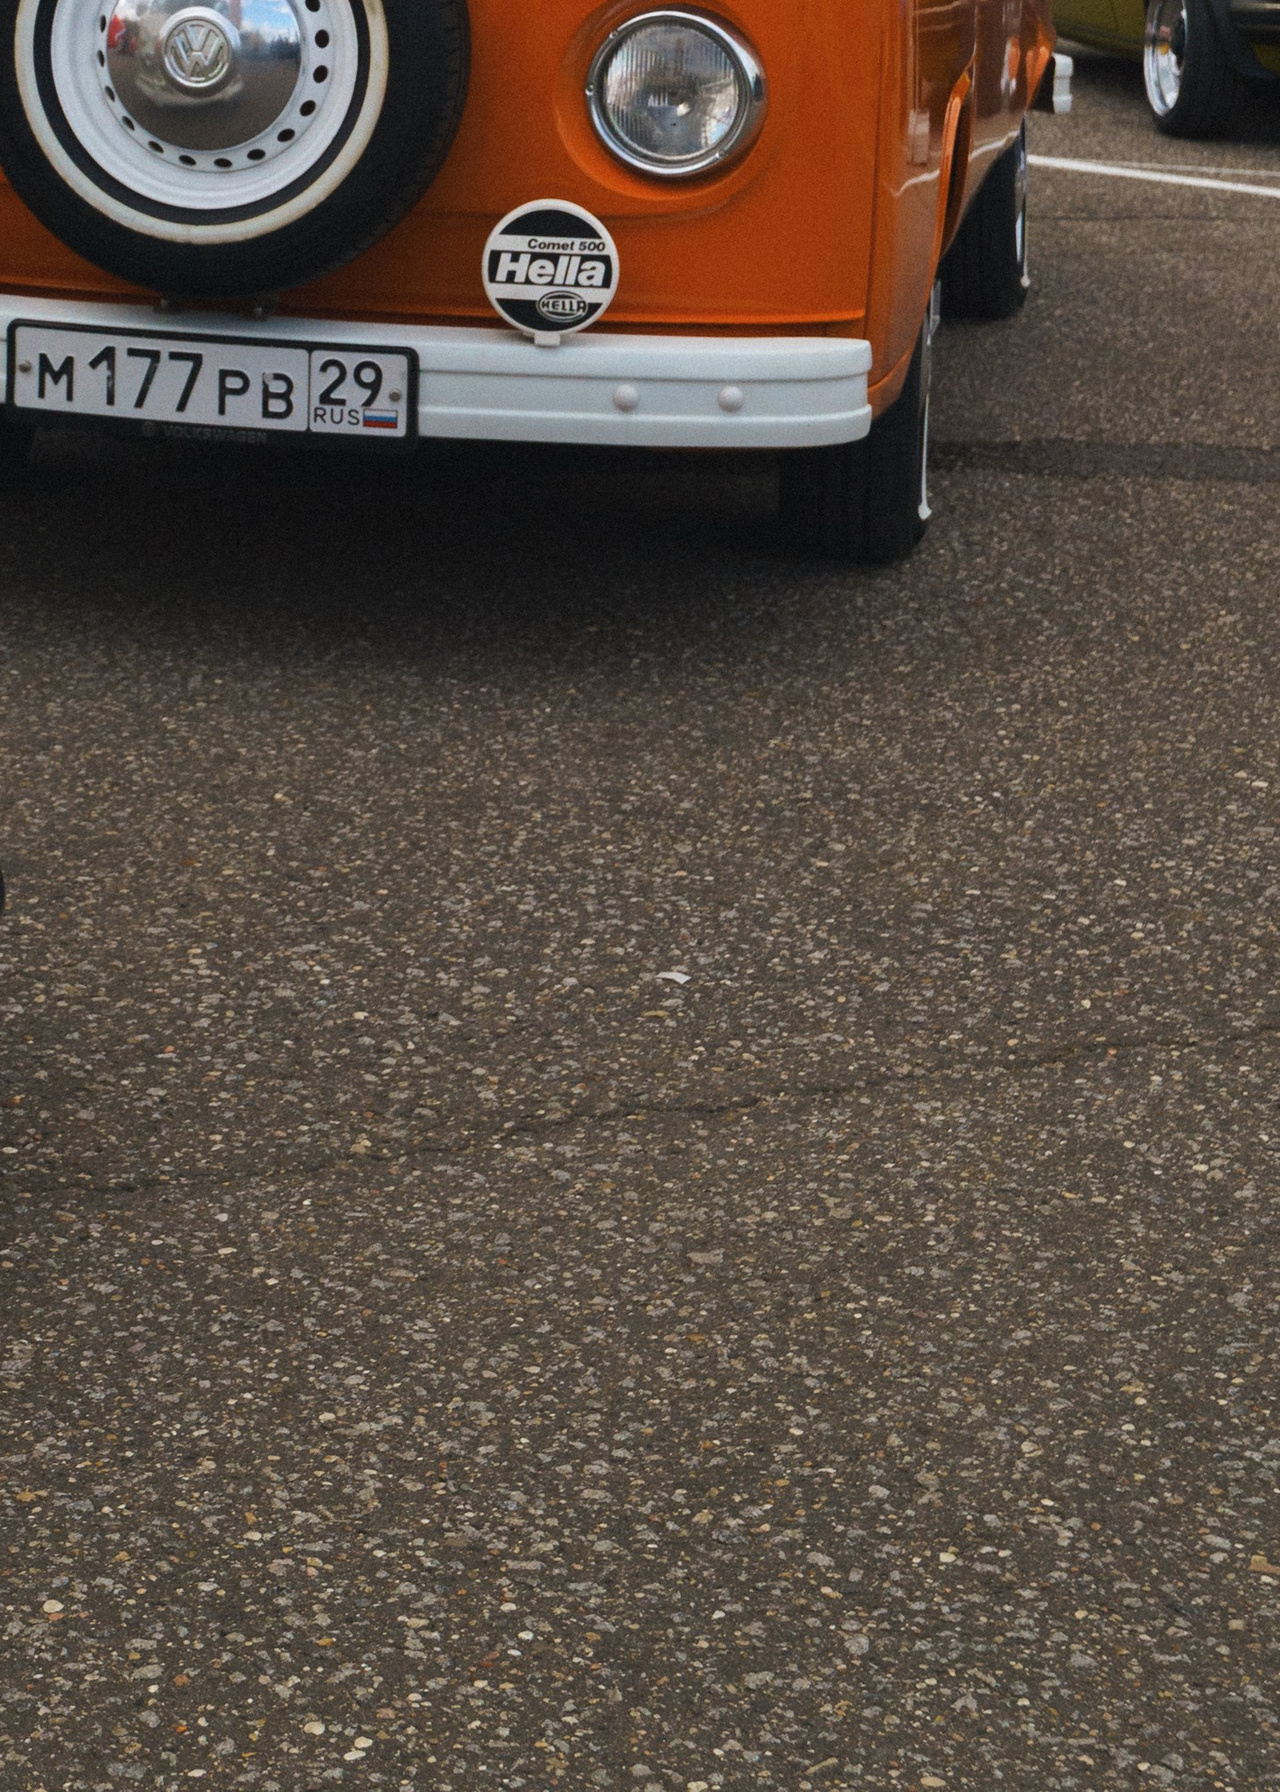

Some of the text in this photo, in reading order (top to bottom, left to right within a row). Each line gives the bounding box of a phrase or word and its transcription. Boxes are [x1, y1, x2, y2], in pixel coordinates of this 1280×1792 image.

[527, 238, 606, 252] Comet 500
[494, 252, 606, 287] Hella
[541, 299, 587, 314] HELLA
[319, 358, 383, 408] 29
[313, 406, 360, 426] RUS
[162, 425, 268, 445] VOLKSWAGEN
